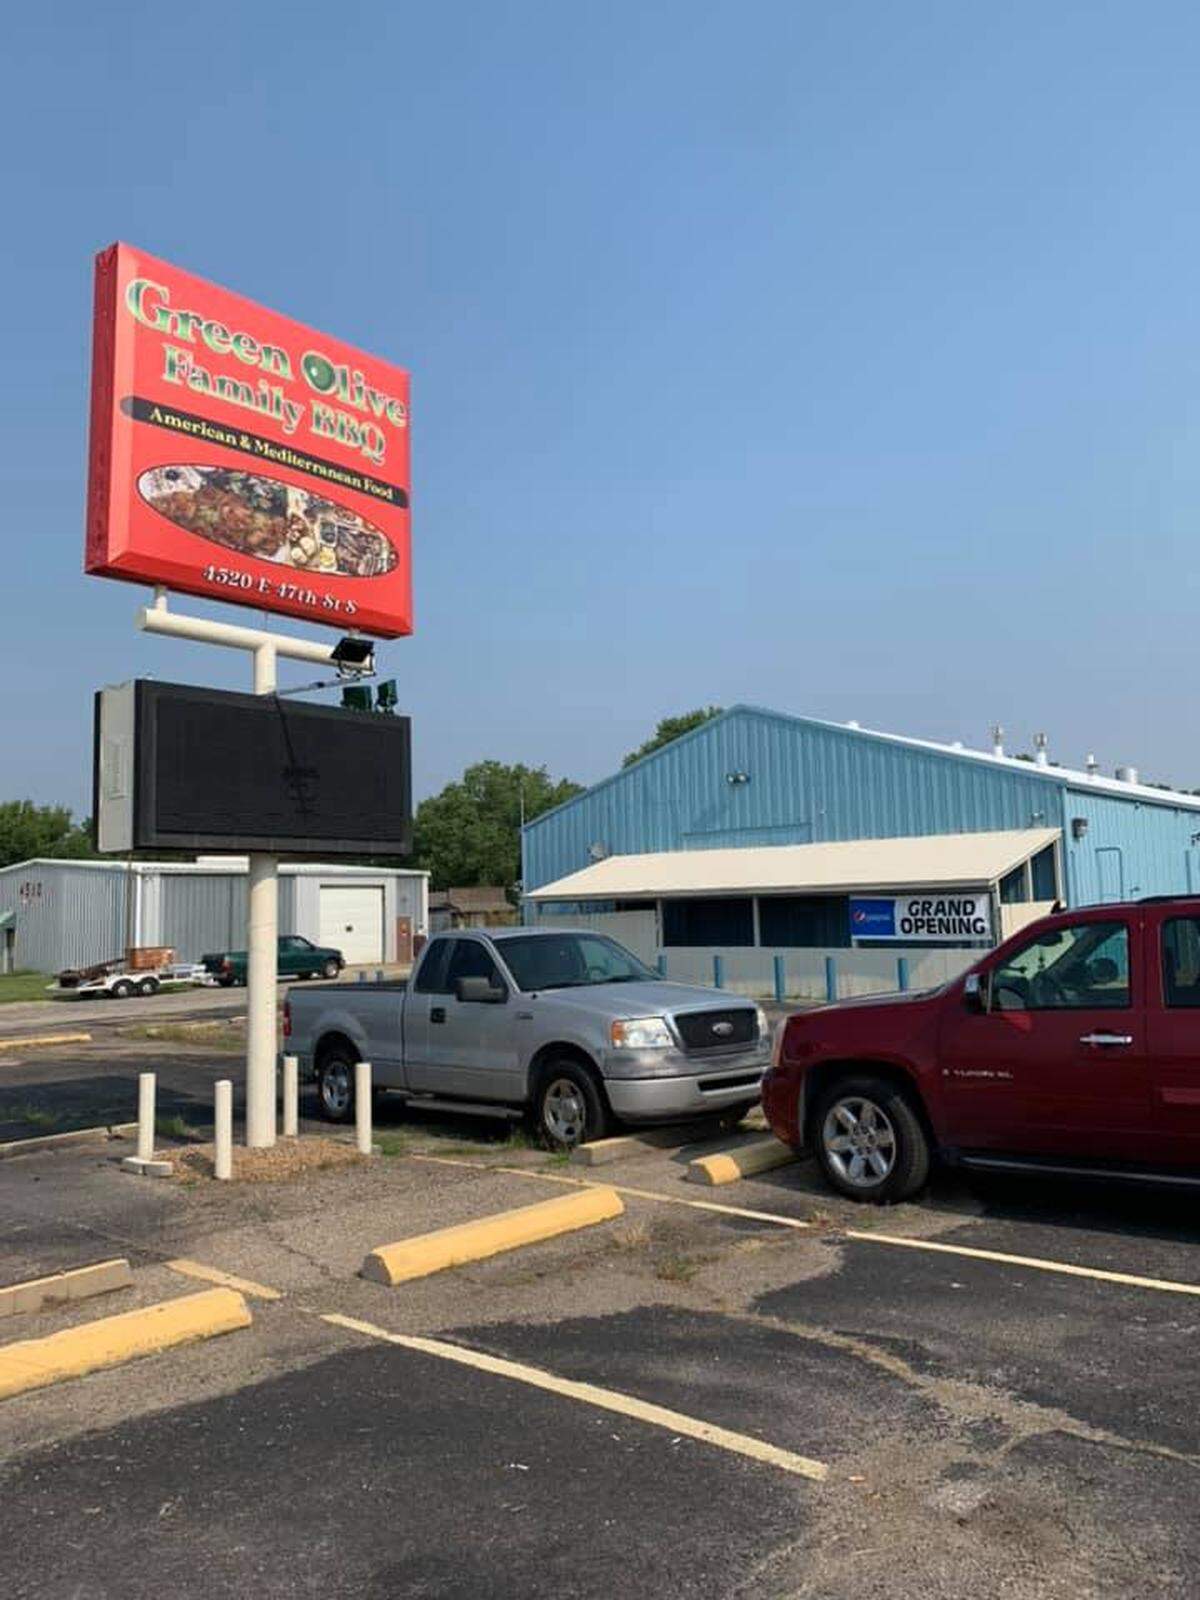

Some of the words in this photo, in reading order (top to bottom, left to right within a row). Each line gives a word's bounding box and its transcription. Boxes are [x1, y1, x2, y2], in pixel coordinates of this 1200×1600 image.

[126, 278, 294, 381] Green
[301, 350, 407, 428] Olive
[162, 343, 306, 435] Family
[310, 400, 386, 466] BBQ
[150, 407, 238, 447] American
[239, 434, 252, 450] &
[254, 439, 362, 488] Mediterranean
[363, 478, 393, 500] Food
[203, 565, 252, 589] 4520
[277, 582, 317, 605] 47th
[345, 599, 359, 614] S
[900, 917, 986, 935] OPENING
[908, 900, 976, 917] GRAND
